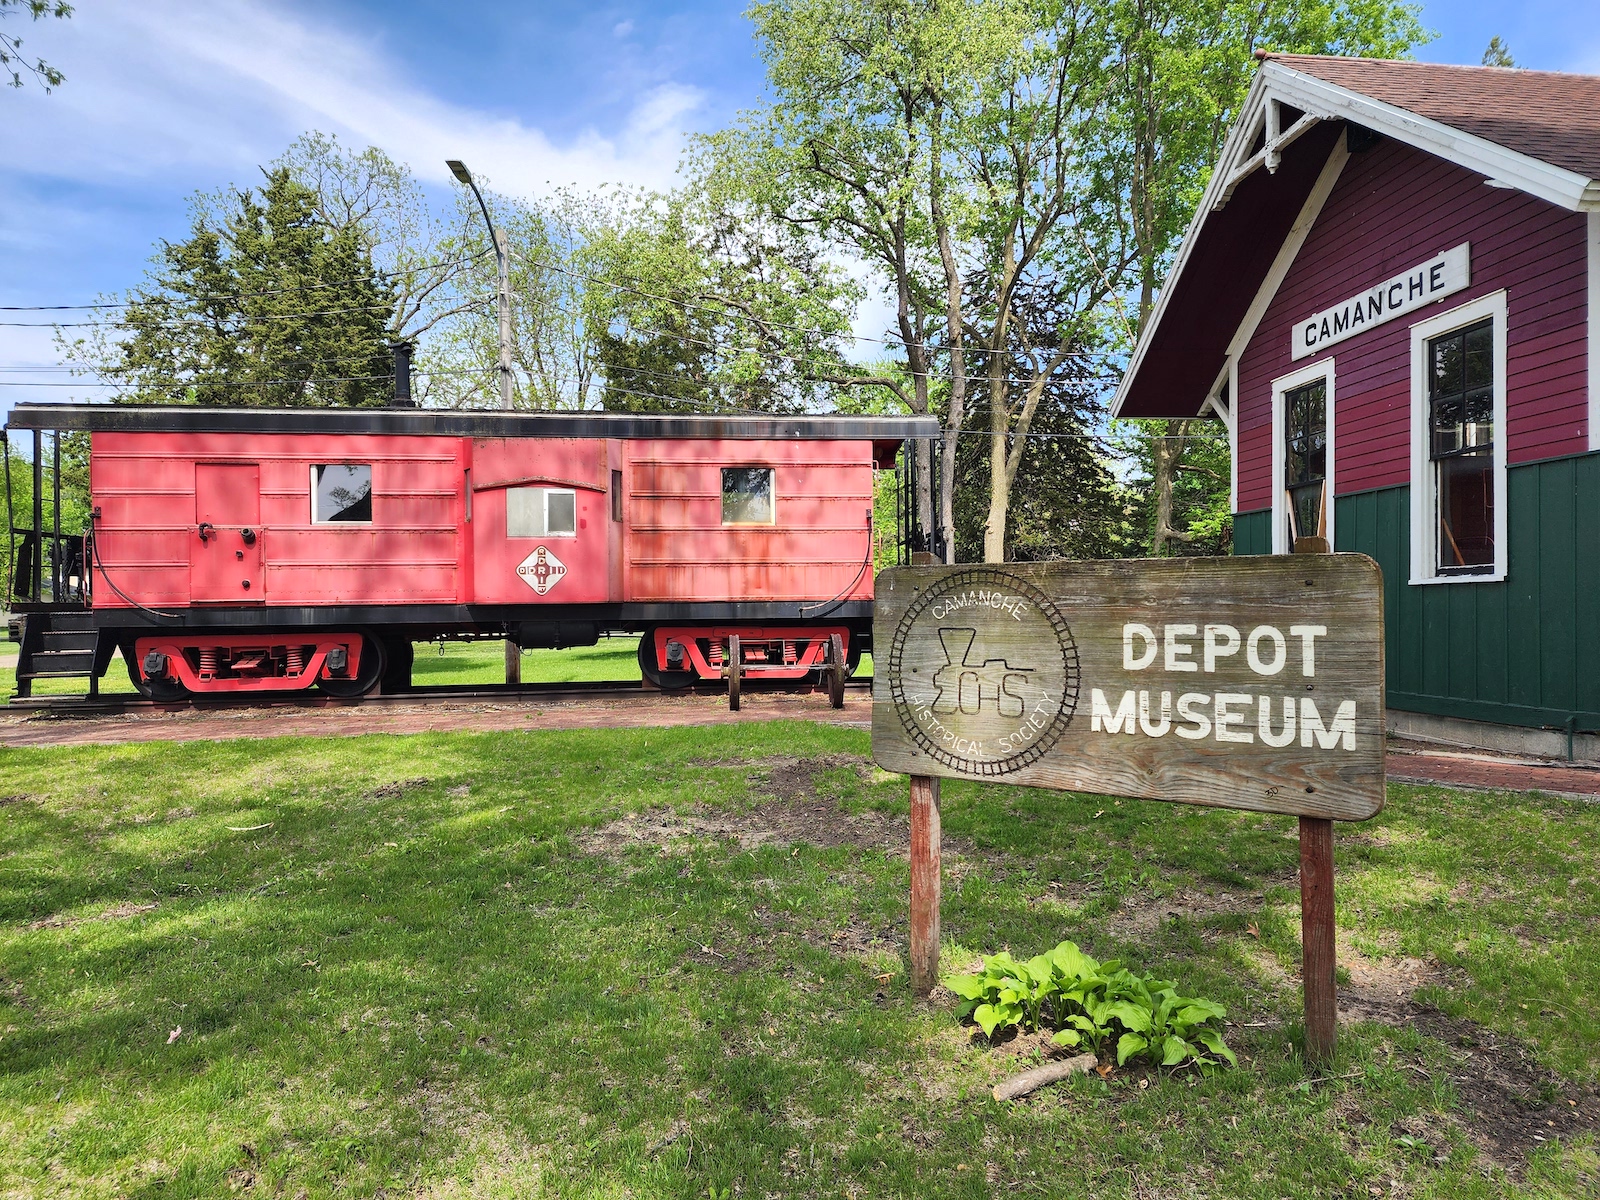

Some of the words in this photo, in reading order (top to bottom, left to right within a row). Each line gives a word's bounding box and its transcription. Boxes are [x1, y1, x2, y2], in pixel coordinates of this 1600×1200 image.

[1305, 261, 1446, 347] CAMANCHE
[931, 590, 1028, 622] CAMANCHE
[1122, 622, 1328, 678] DEPOT
[911, 693, 989, 757] HISTORICAL
[998, 690, 1055, 754] SOCIETY
[1090, 688, 1357, 752] MUSEUM
